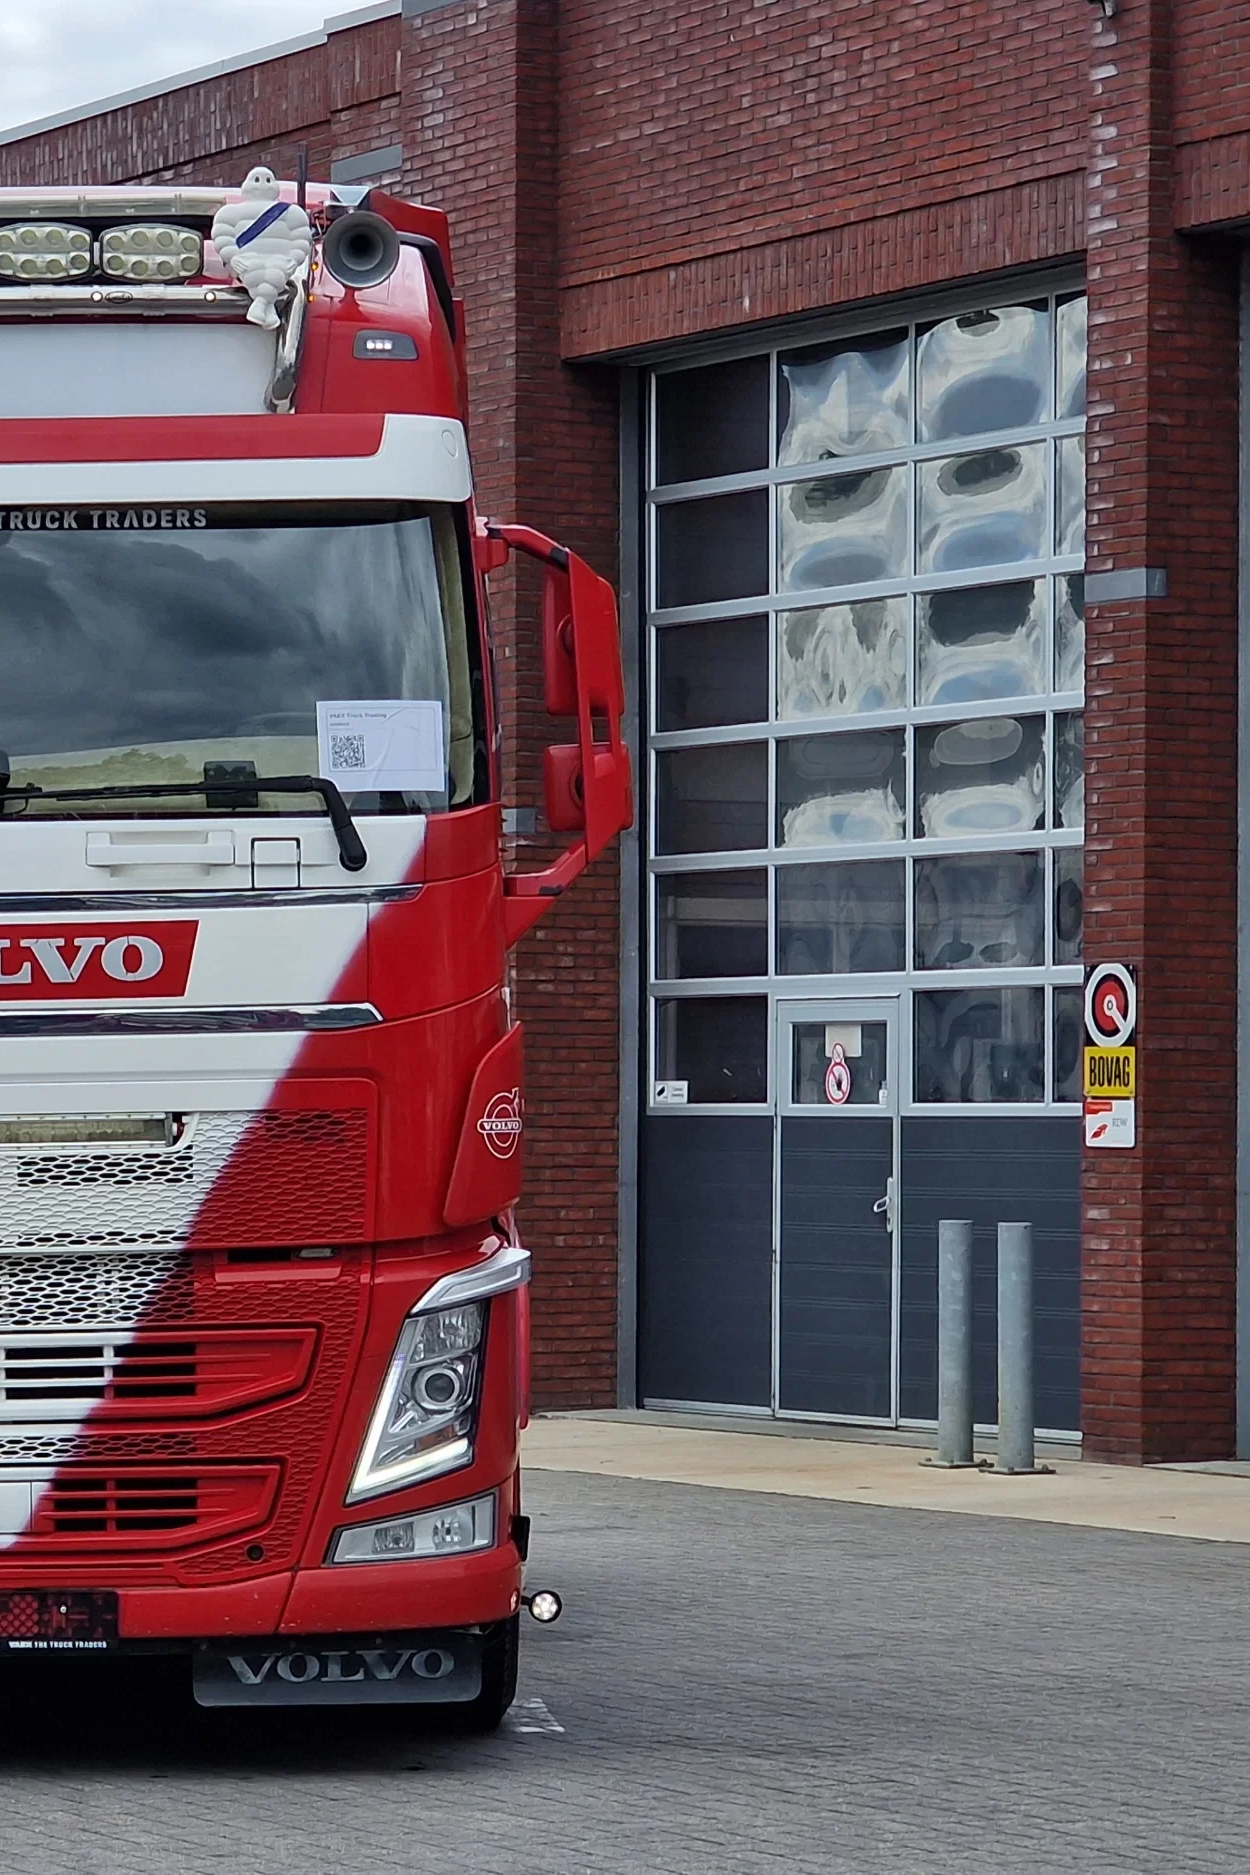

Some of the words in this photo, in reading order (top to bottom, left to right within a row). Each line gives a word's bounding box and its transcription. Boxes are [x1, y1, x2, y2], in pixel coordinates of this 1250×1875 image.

[89, 508, 207, 529] TRADERS
[1089, 1055, 1131, 1088] BOVAG
[482, 1121, 519, 1131] VOLVO
[34, 1641, 48, 1649] THE
[49, 1641, 73, 1649] TRUCK
[226, 1649, 455, 1685] VOLVO
